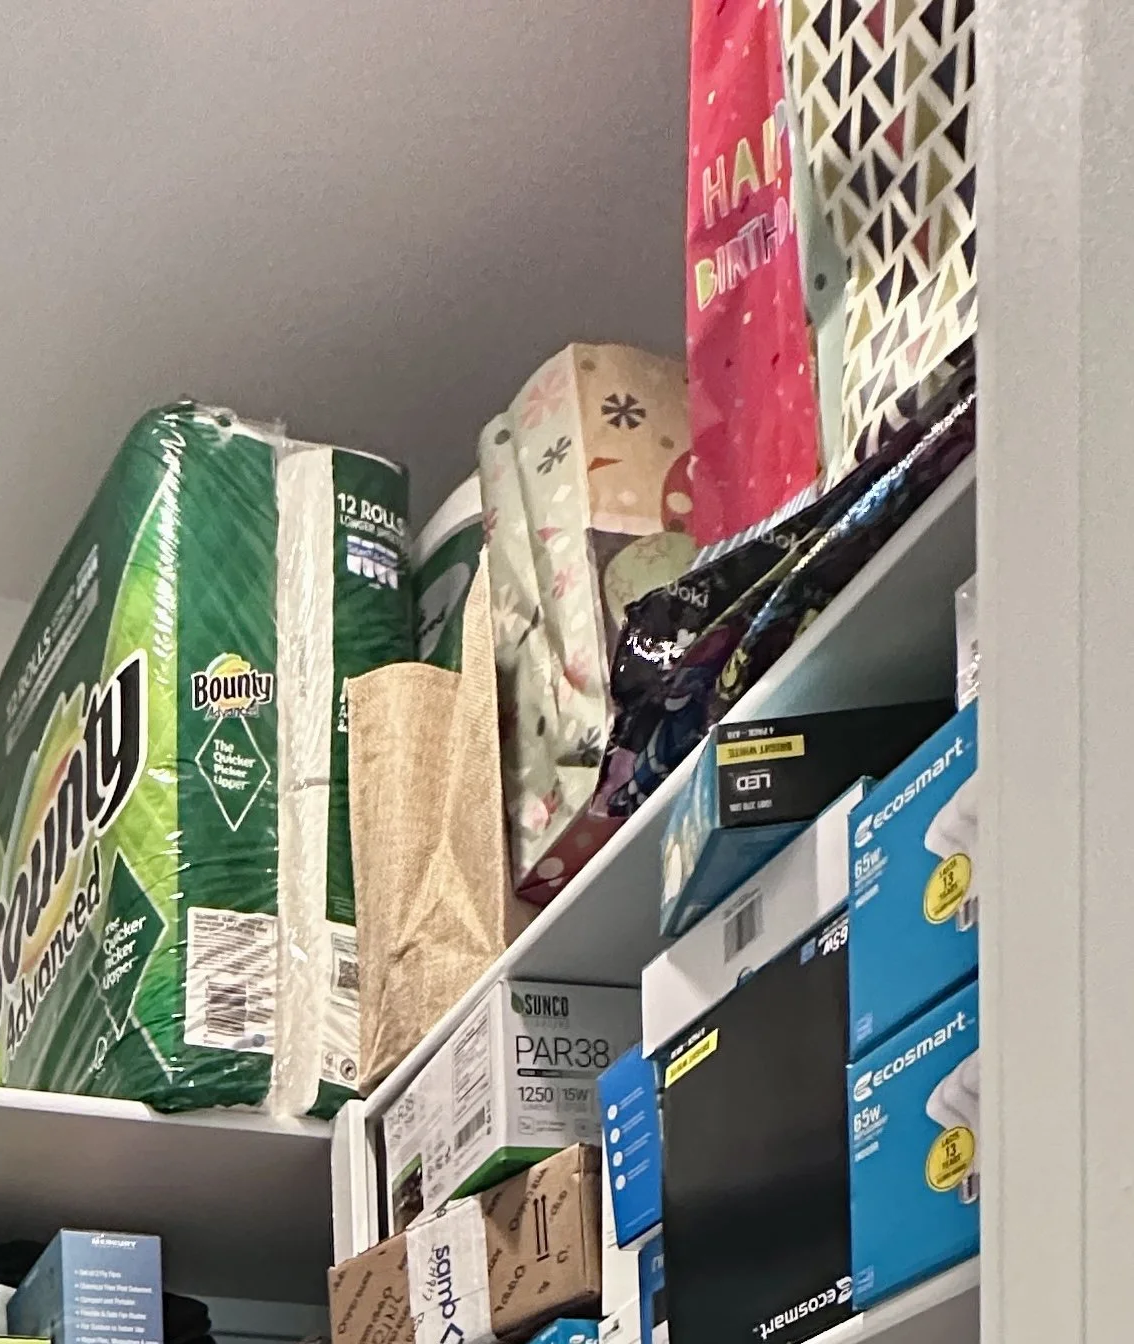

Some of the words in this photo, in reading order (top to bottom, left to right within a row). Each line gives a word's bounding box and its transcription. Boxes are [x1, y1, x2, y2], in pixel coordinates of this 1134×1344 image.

[336, 492, 357, 517] 12
[192, 671, 273, 710] Bounty
[213, 738, 235, 752] The
[212, 751, 257, 769] Quicker
[736, 773, 772, 792] LED
[873, 734, 964, 831] ecosmart
[4, 842, 102, 1054] Advanced
[523, 993, 570, 1018] SUNCO
[515, 1034, 610, 1069] PAR38
[872, 1010, 967, 1088] ecosmart
[517, 1086, 554, 1105] 1250
[853, 1103, 882, 1132] 65w
[944, 1142, 957, 1158] 13
[760, 1285, 838, 1342] ecosmart
